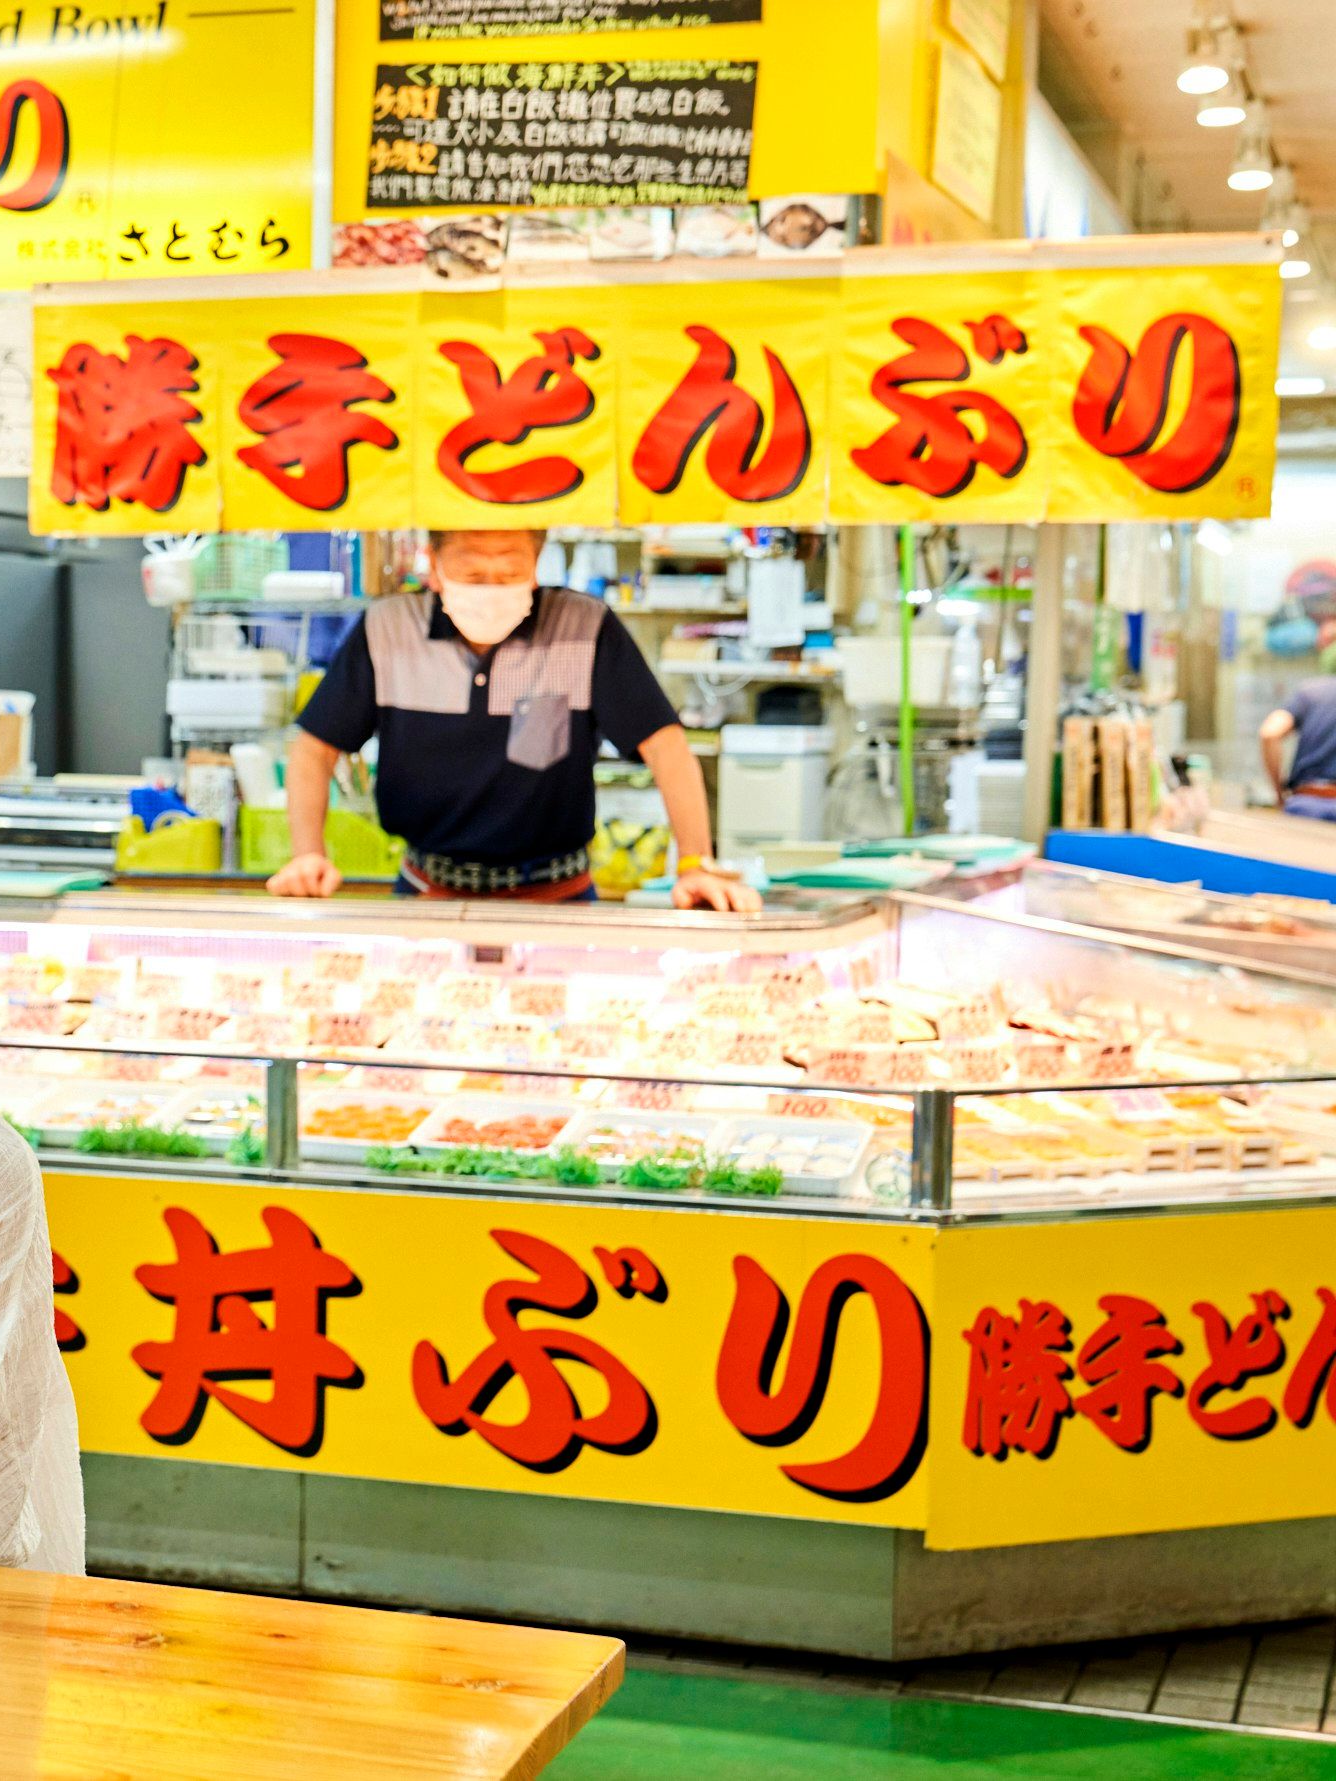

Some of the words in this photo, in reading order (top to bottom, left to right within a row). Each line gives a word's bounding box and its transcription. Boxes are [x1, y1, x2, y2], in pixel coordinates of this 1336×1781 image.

[42, 1, 166, 43] Bowl
[120, 219, 290, 262] さとむら
[46, 312, 1243, 512] 勝手どんぶり
[779, 1100, 827, 1117] 100
[52, 1206, 931, 1503] 丼ぶり
